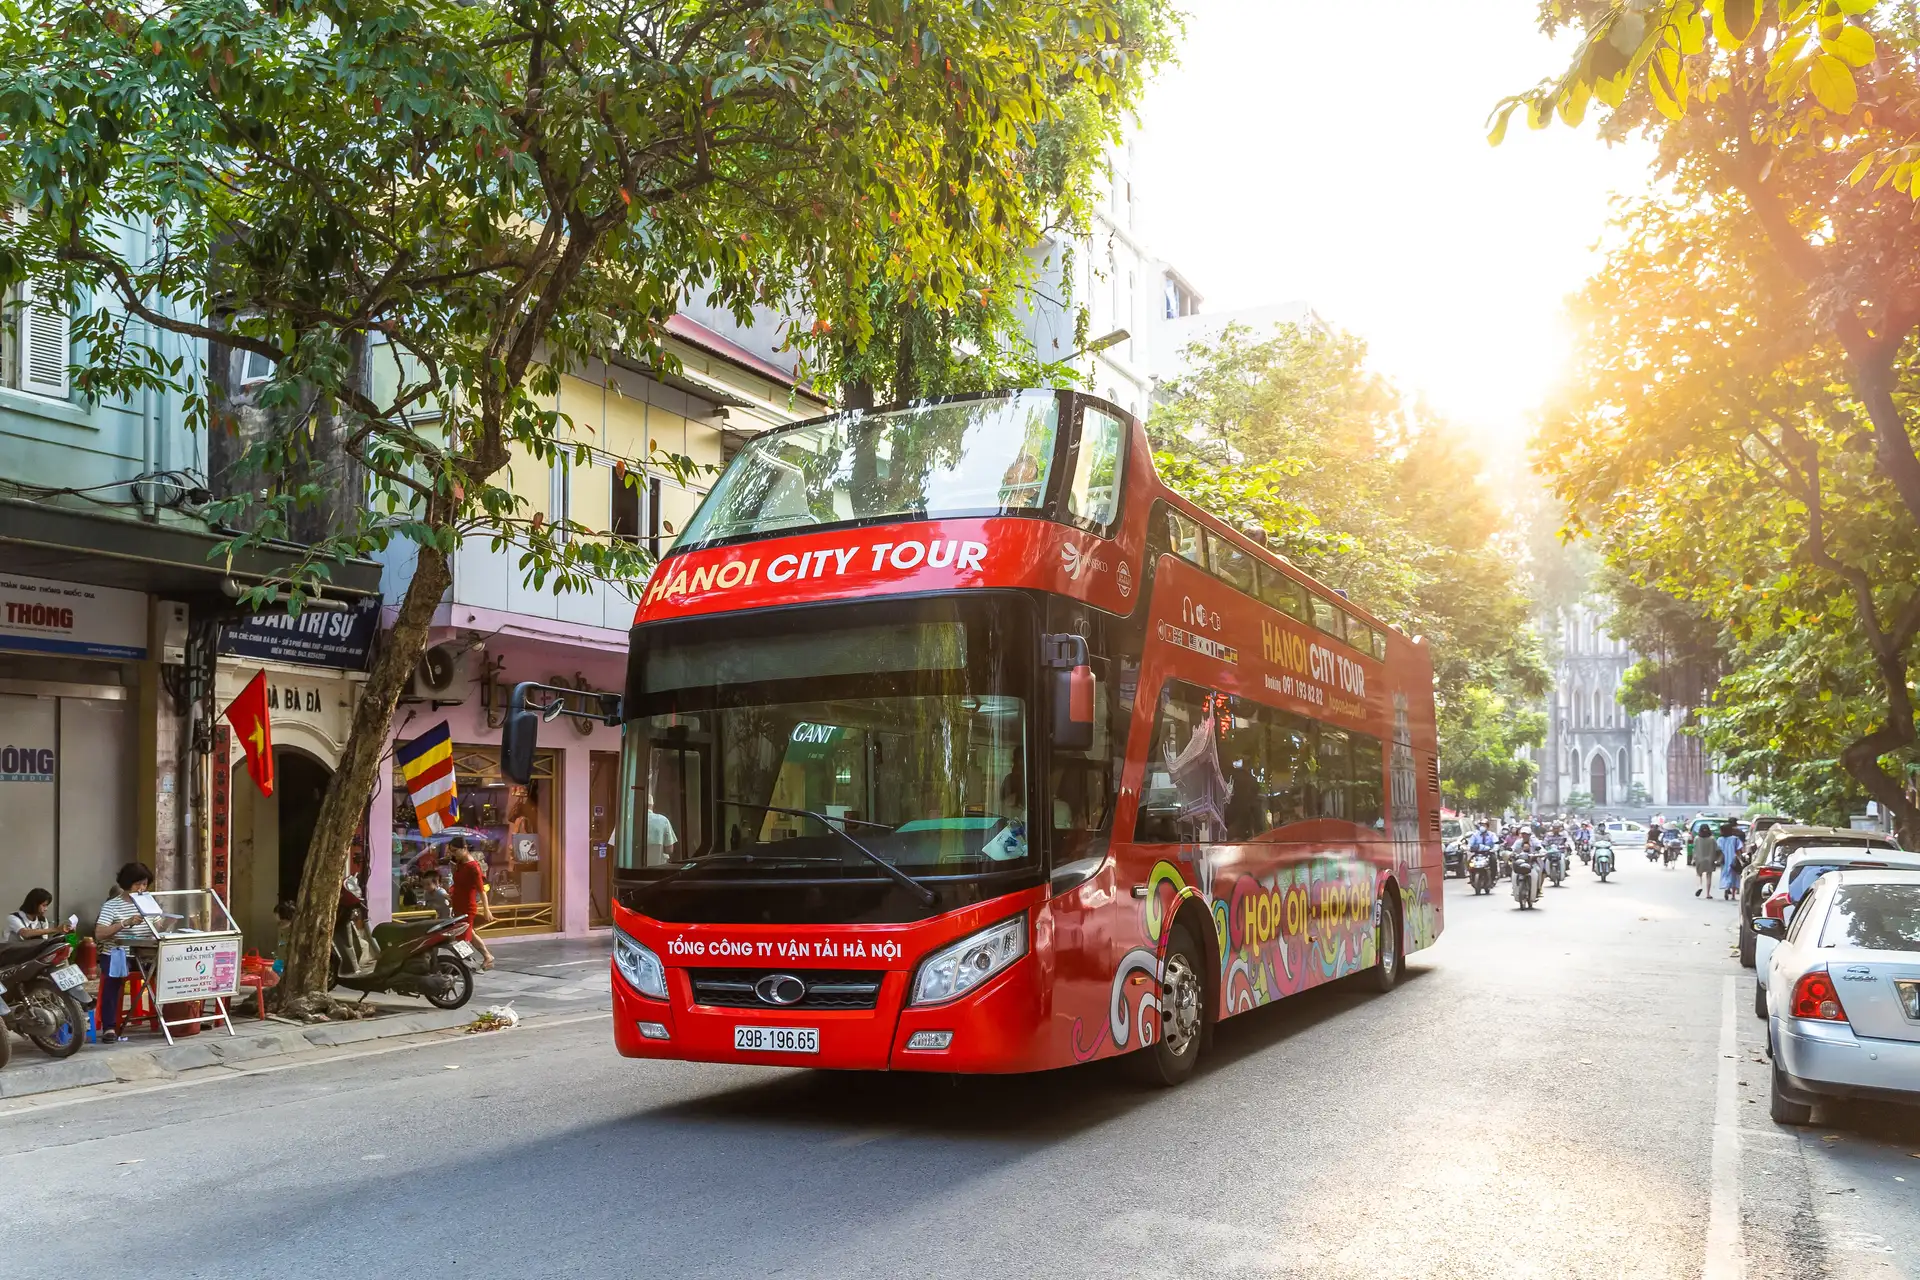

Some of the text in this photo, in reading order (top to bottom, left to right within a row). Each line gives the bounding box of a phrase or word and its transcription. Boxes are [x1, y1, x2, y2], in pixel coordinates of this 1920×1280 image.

[645, 540, 988, 606] HANOI CITY TOUR
[6, 602, 73, 628] THÔNG
[300, 612, 329, 639] TRỊ
[329, 612, 358, 641] SỰ
[1261, 619, 1366, 699] HANOI CITY TOUR
[285, 686, 301, 711] BÀ
[306, 687, 322, 713] ĐÁ
[1265, 673, 1324, 706] Booking 091 193 82 82
[792, 722, 837, 745] GANT
[0, 744, 54, 775] ÔNG
[1245, 891, 1281, 957] HOP
[1320, 885, 1346, 940] HOP
[1351, 882, 1371, 922] OFF
[186, 944, 203, 954] ĐẠI
[667, 934, 902, 963] TỔNG CÔNG TY VẬN TẢI HÀ NỘI
[736, 1029, 817, 1051] 29B-196.65
